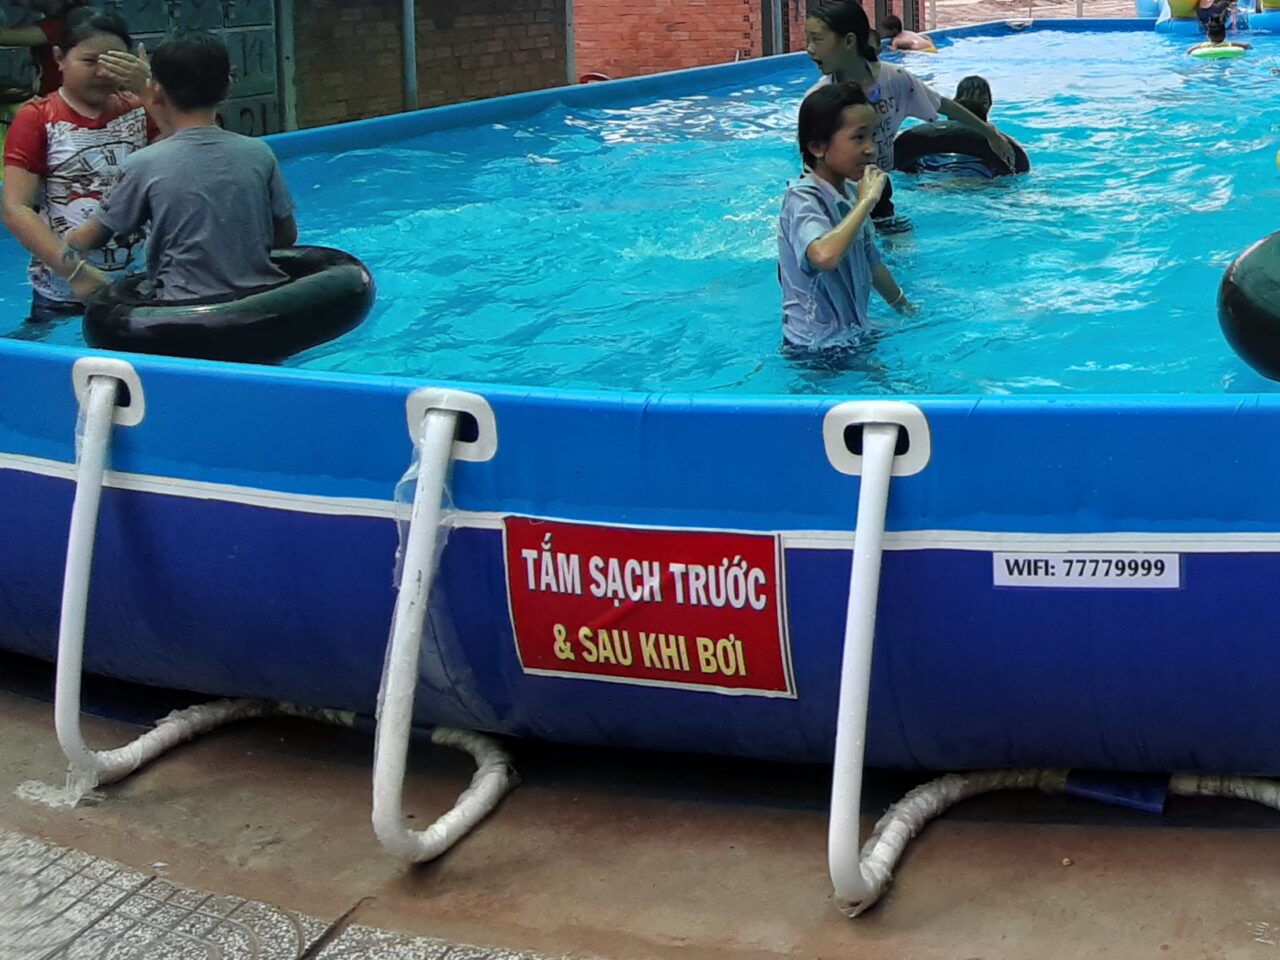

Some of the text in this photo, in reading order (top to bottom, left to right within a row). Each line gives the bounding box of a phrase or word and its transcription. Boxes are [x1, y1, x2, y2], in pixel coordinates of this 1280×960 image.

[521, 533, 767, 610] TẮM SẠCH TRƯỚC
[1005, 559, 1165, 577] WIFI: 77779999
[553, 623, 746, 676] & SAU KHI BƠI
